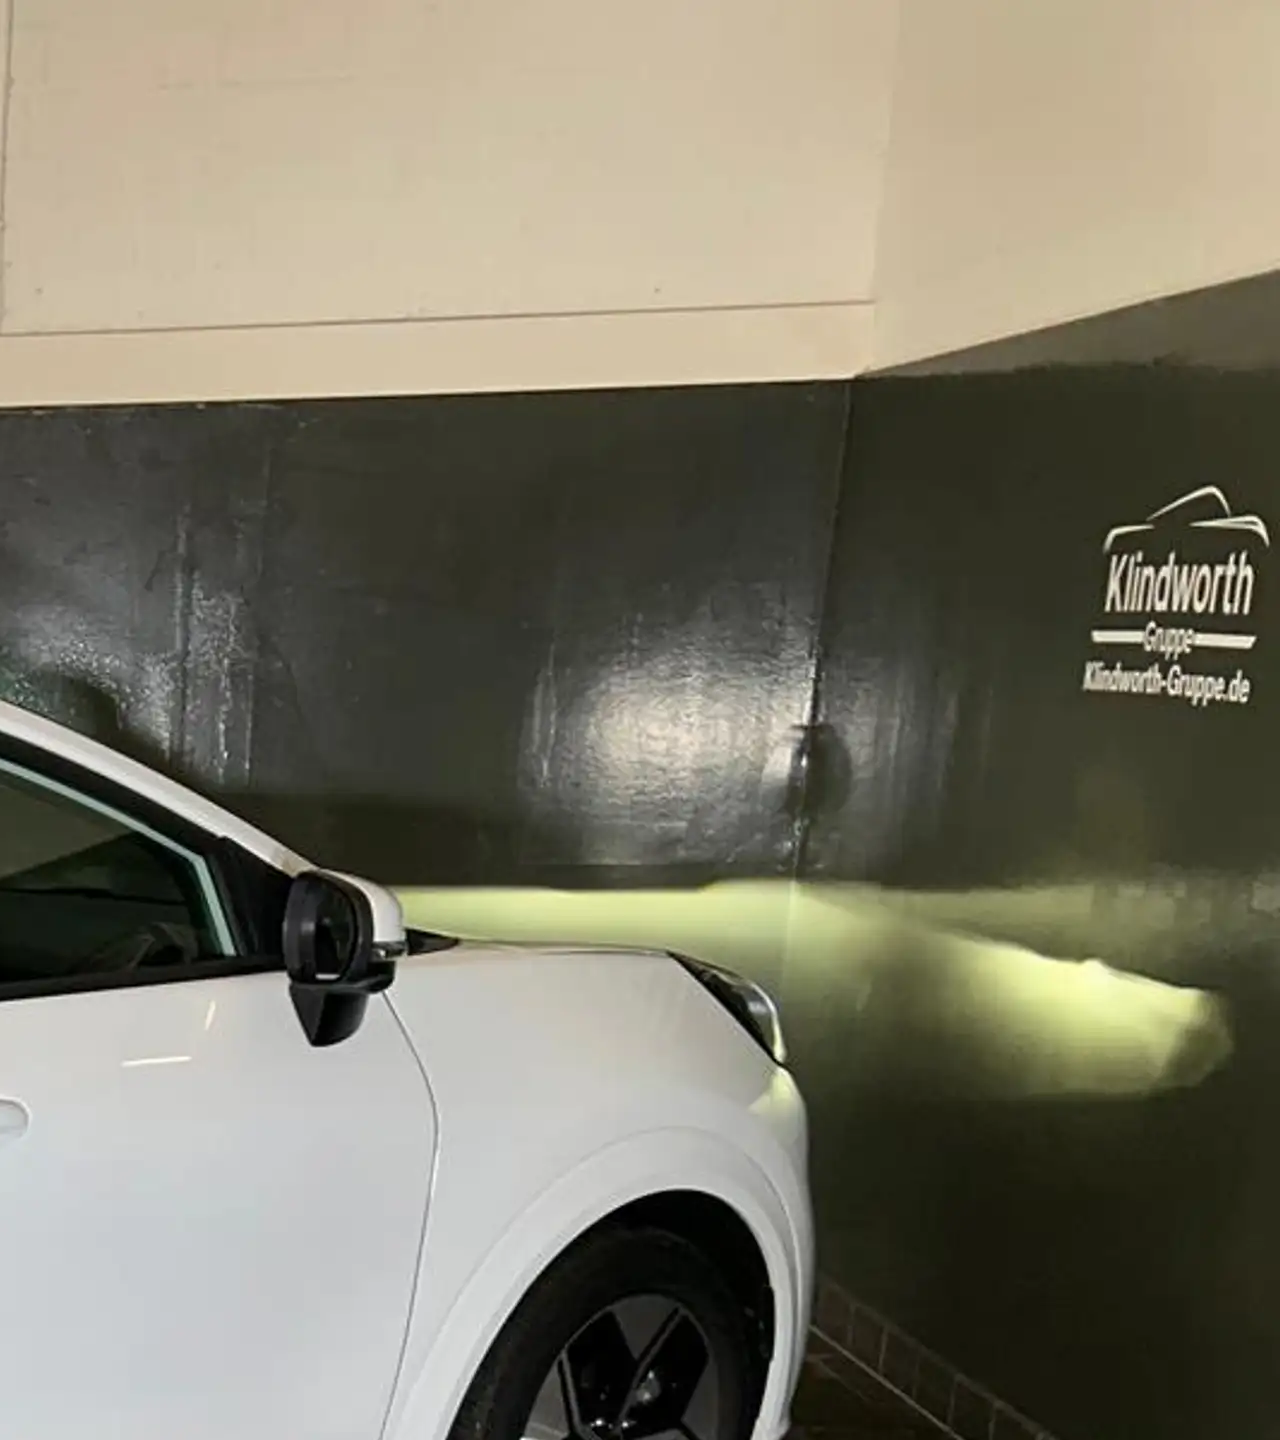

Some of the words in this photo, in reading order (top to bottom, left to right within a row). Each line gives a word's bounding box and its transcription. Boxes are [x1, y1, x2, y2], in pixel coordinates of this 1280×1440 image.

[1104, 550, 1255, 616] Klindworth
[1143, 619, 1195, 661] Gruppe
[1082, 660, 1251, 707] Klindworth-Gruppe.de
